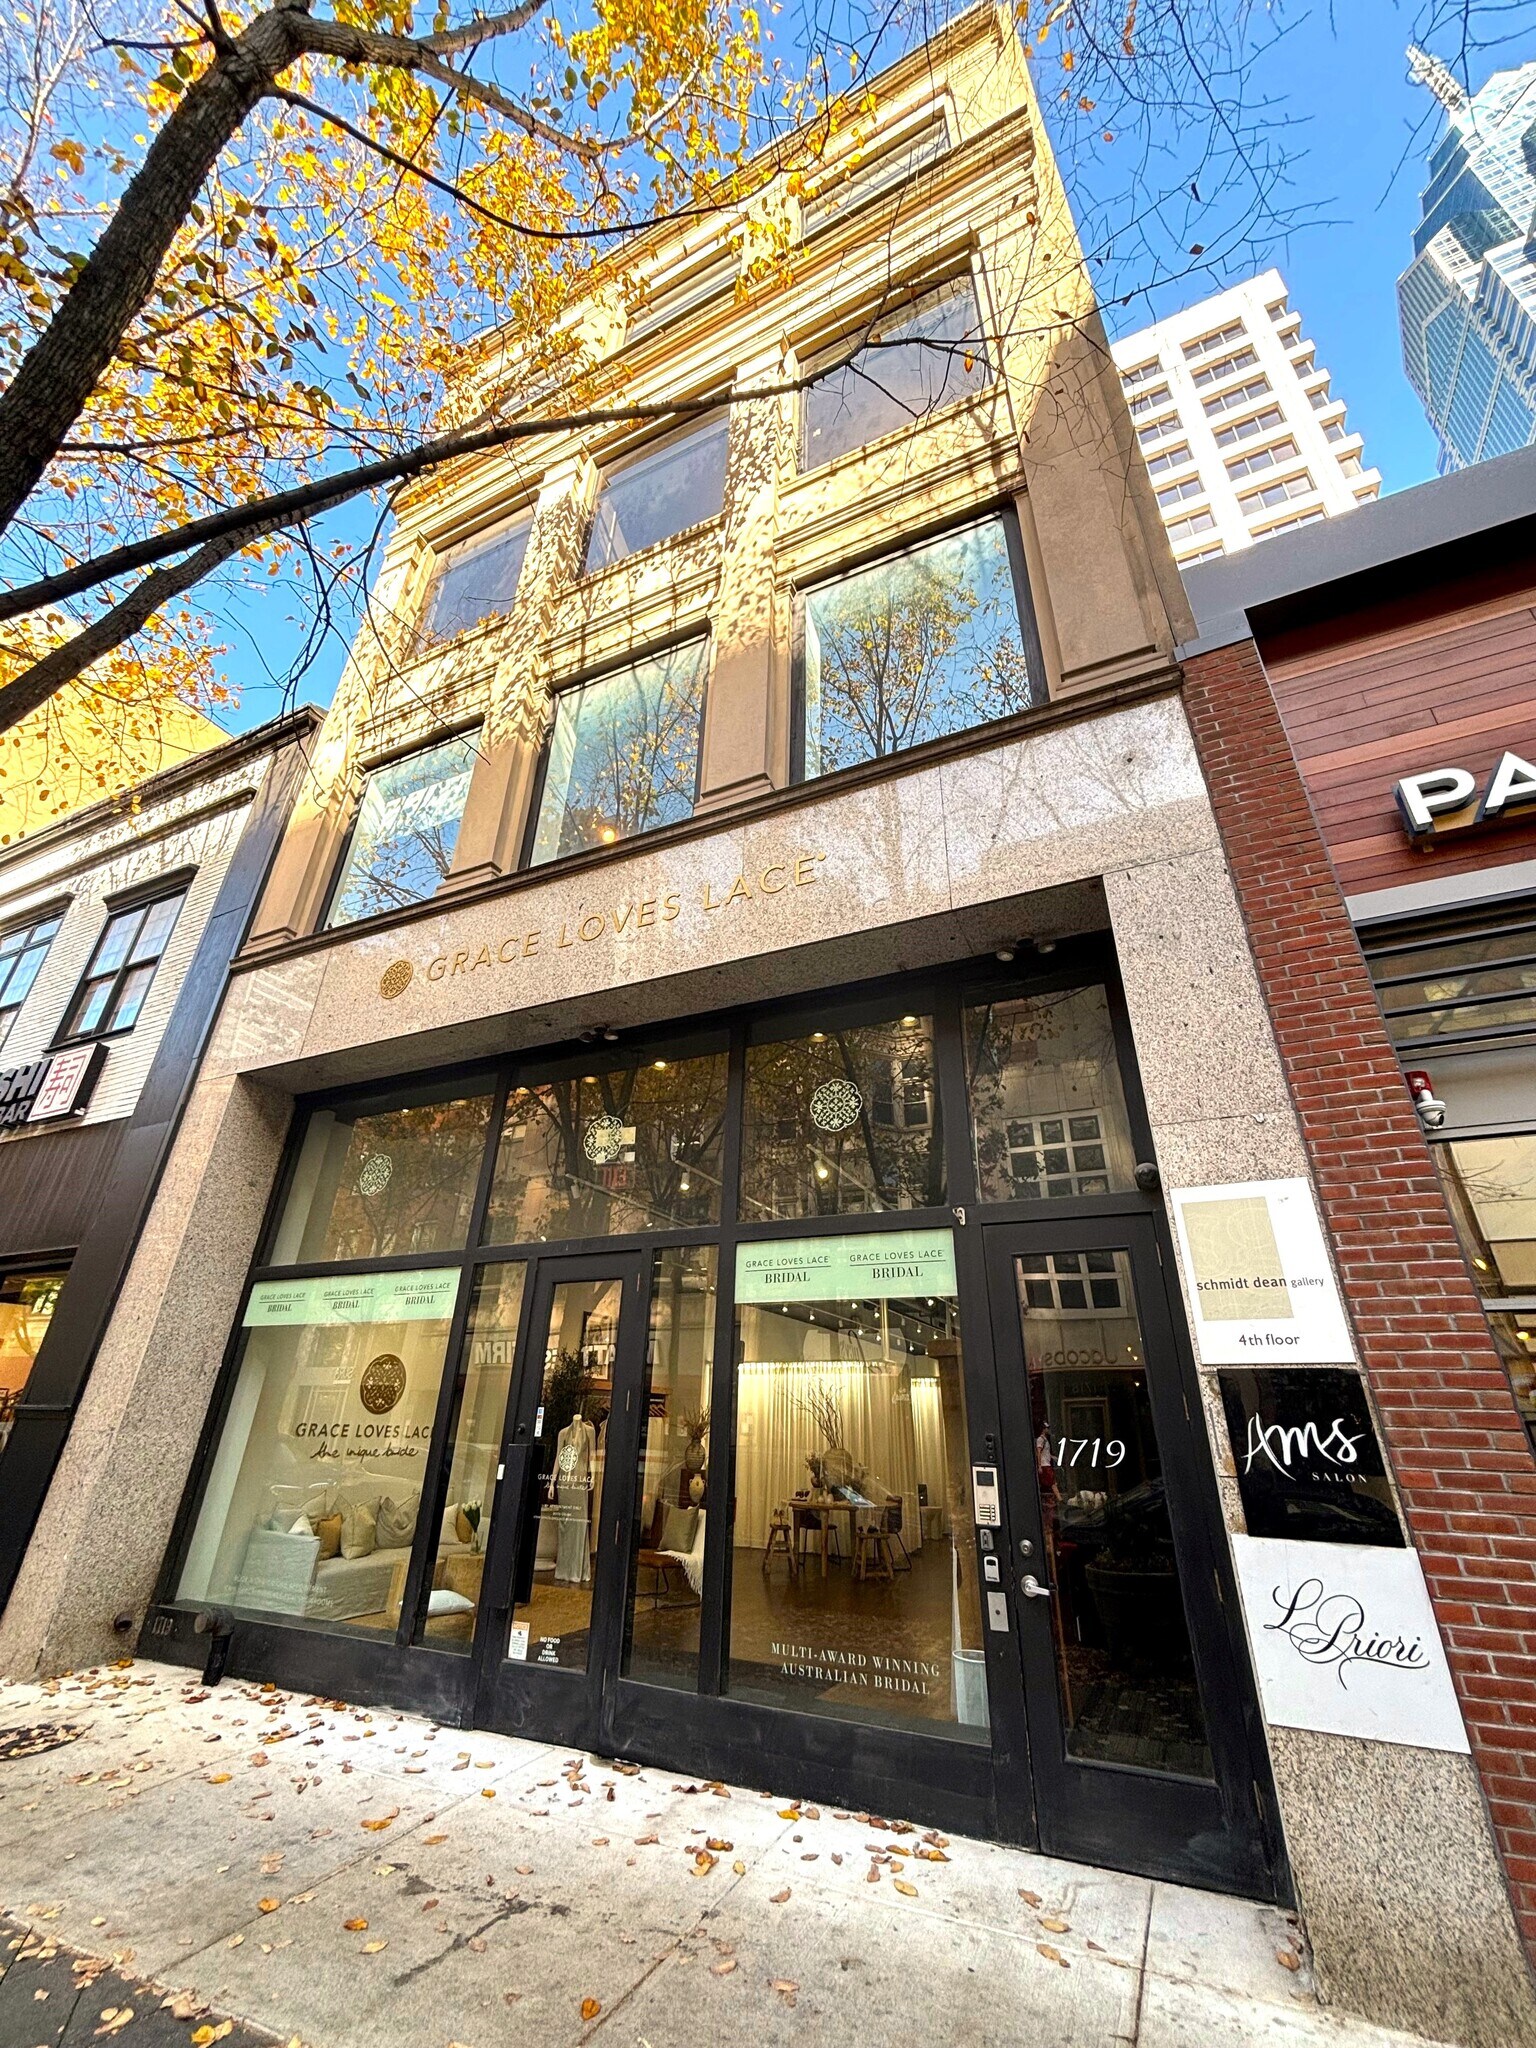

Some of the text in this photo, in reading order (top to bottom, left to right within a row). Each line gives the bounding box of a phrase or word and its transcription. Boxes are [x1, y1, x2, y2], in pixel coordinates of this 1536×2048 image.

[1397, 750, 1536, 831] PA
[425, 853, 817, 982] GRACE LOVES LACE
[745, 1255, 829, 1268] GRACE LOVES LACE
[850, 1249, 943, 1262] GRACE LOVES LACE
[765, 1271, 811, 1284] BRIDAL
[872, 1266, 924, 1279] BRIDAL
[415, 1283, 434, 1291] LOVES
[1196, 1276, 1325, 1291] schmidt dean gallery
[332, 1301, 360, 1309] BRIDAL
[405, 1295, 435, 1305] BRIDAL
[267, 1303, 292, 1312] BRIDAL
[1238, 1333, 1300, 1346] 4th floor
[296, 1422, 434, 1439] GRACE LOVES LAC
[1056, 1437, 1126, 1468] 1719
[1312, 1471, 1368, 1484] SALON
[537, 1655, 559, 1663] ALLOWED
[771, 1642, 941, 1678] MULTI-AWARD WINNING
[780, 1662, 931, 1695] AUSTRALIAN BRIDAL
